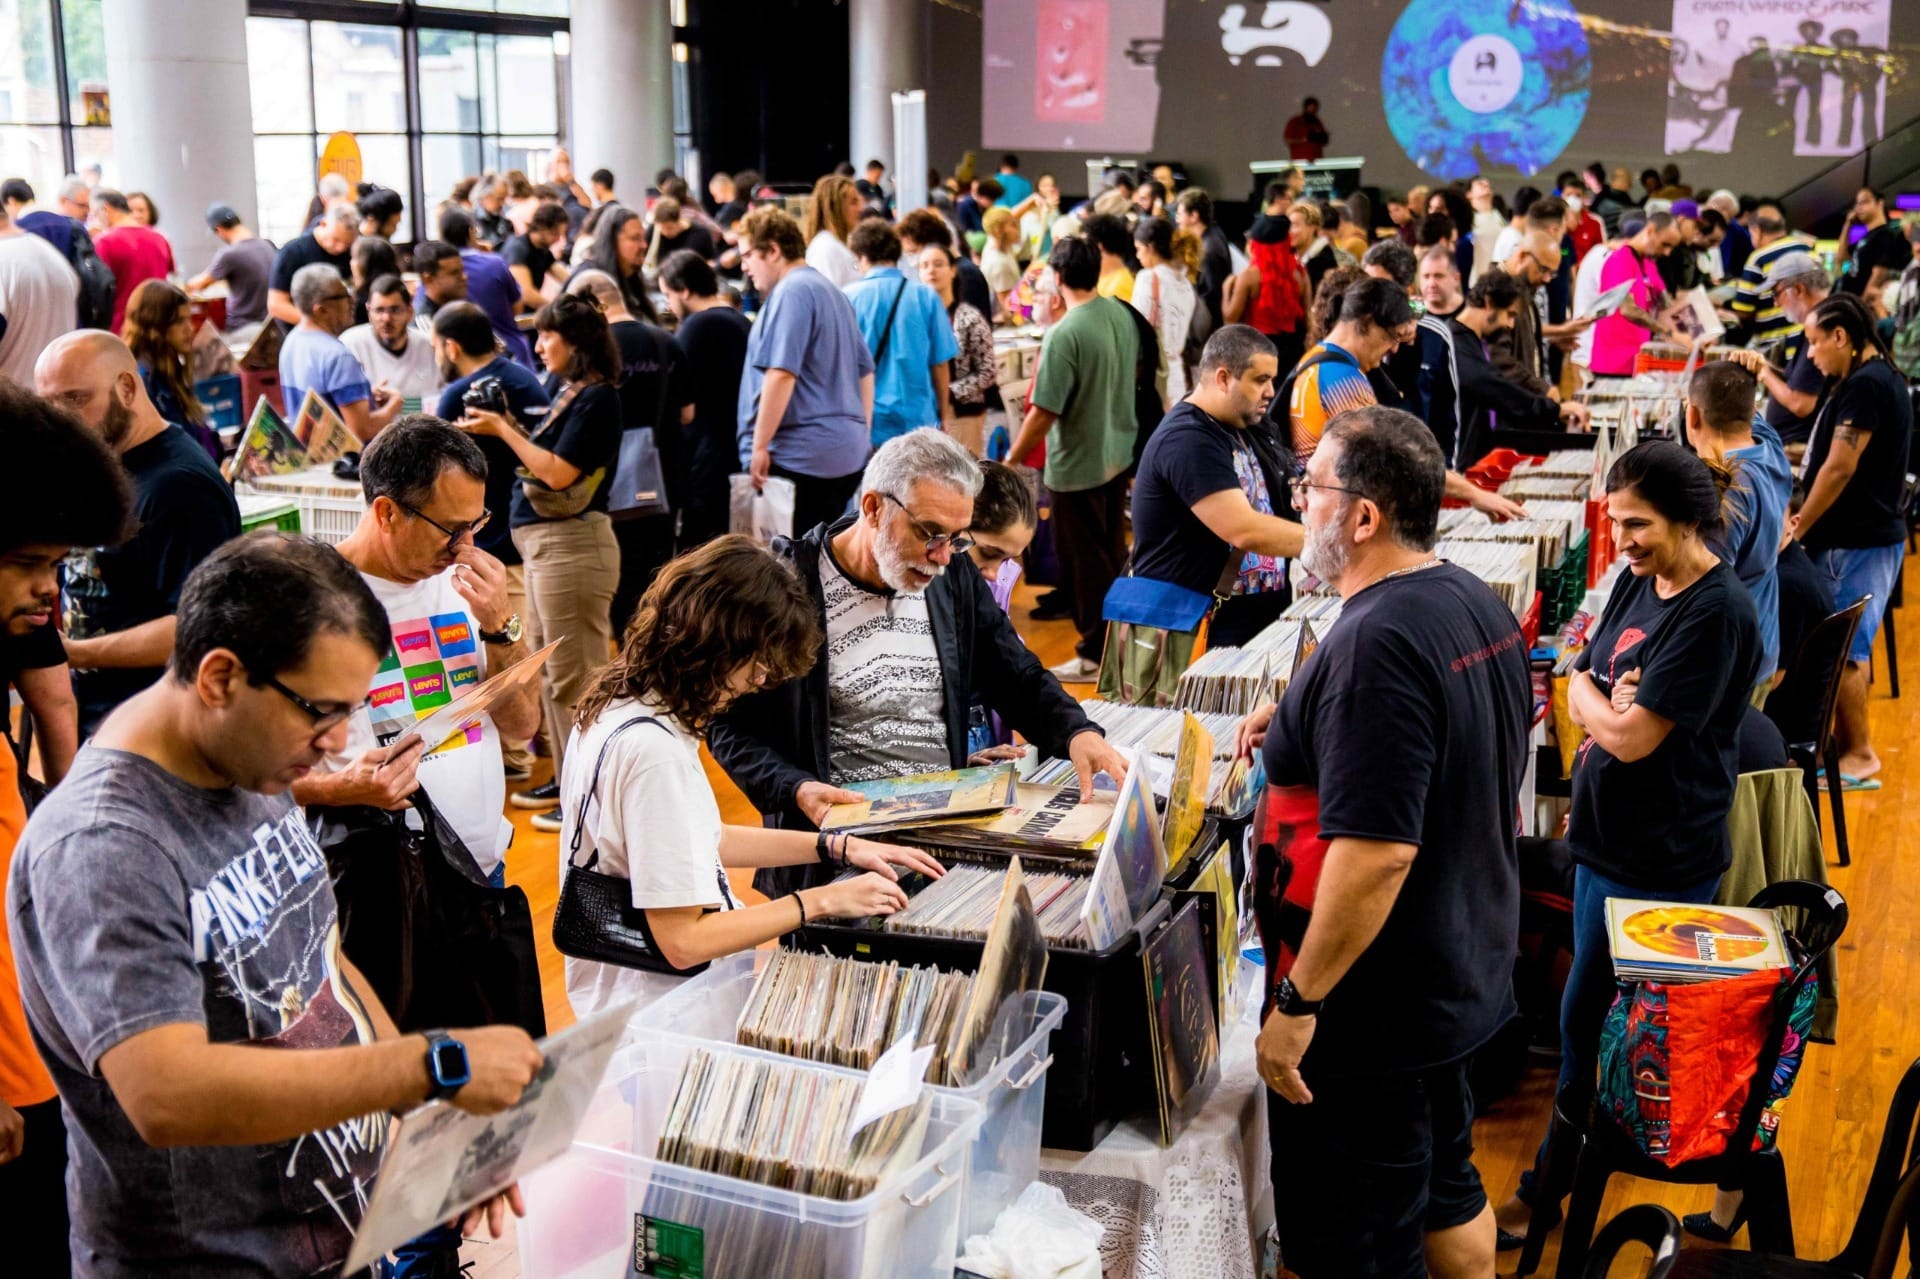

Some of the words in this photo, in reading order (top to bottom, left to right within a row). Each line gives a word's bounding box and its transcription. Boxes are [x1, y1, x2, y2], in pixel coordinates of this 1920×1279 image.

[190, 850, 278, 962] PINK
[252, 806, 328, 898] FLO
[636, 1215, 646, 1272] organize
